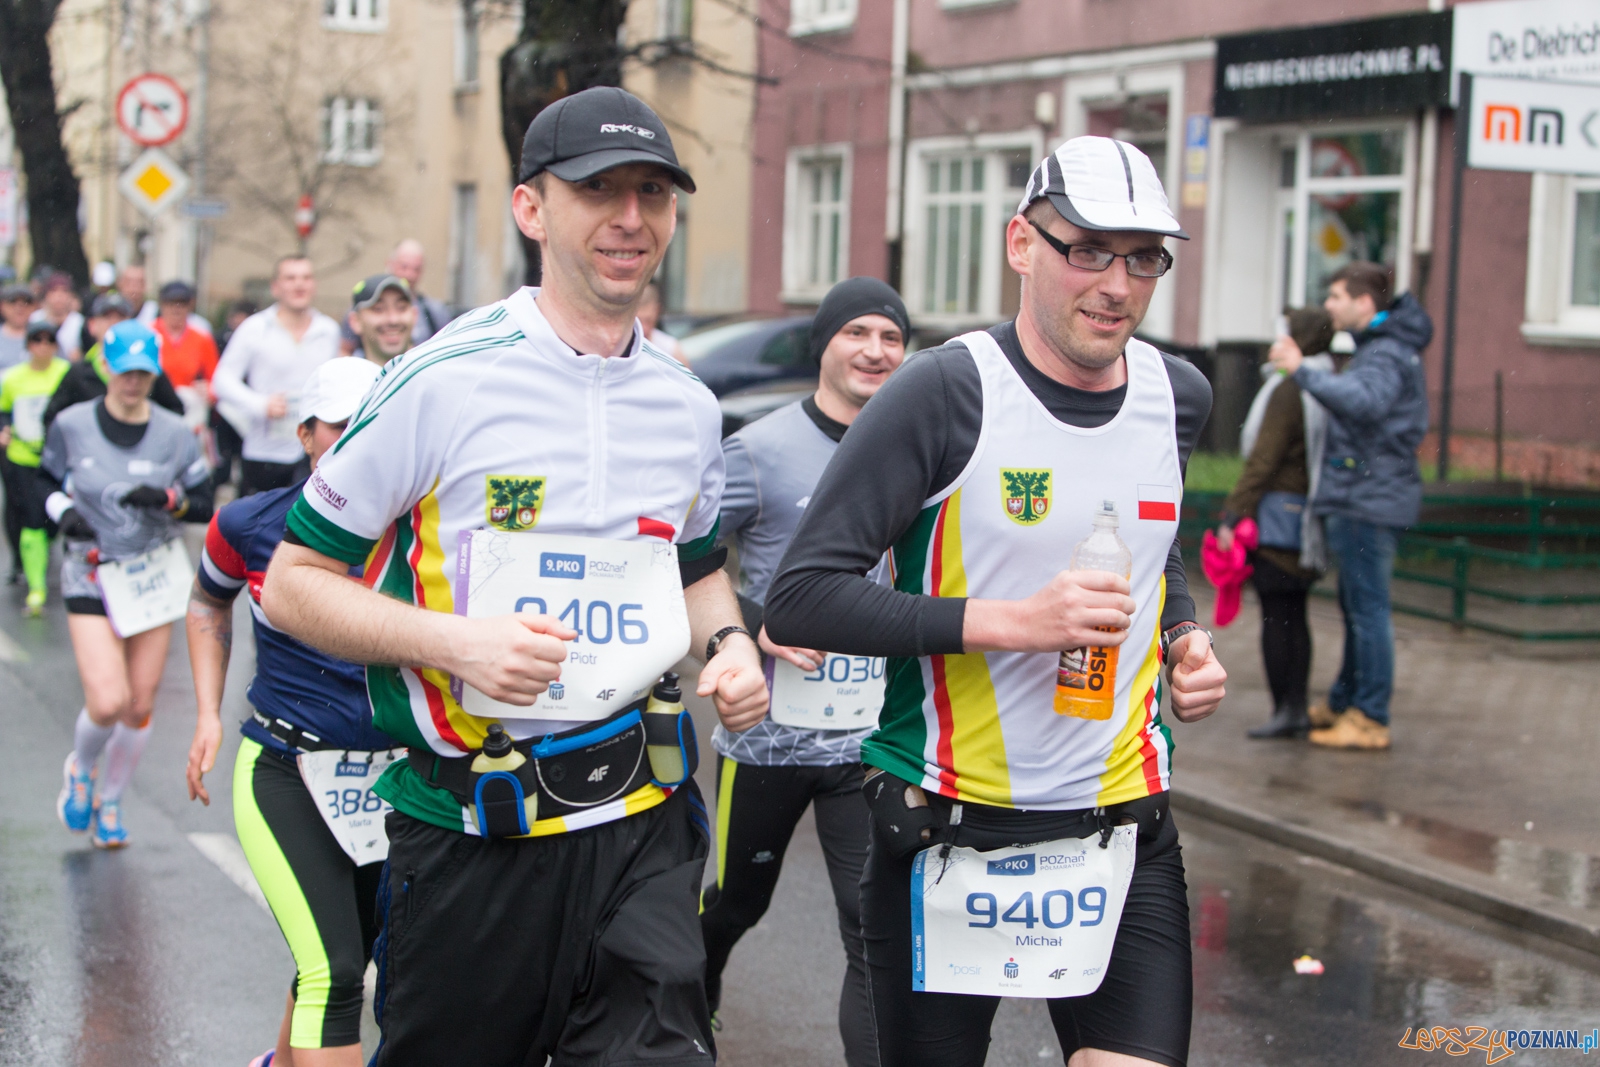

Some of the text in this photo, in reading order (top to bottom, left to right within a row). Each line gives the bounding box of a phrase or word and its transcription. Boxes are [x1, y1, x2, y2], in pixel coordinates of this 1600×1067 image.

[1488, 31, 1516, 61] De
[546, 559, 580, 573] 9.PKO
[570, 651, 598, 665] Piotr
[596, 688, 616, 701] 4F
[587, 764, 609, 782] 4F
[325, 788, 395, 819] 388
[966, 886, 1107, 929] 9409
[1015, 935, 1063, 947] Michał
[1048, 968, 1068, 980] 4F
